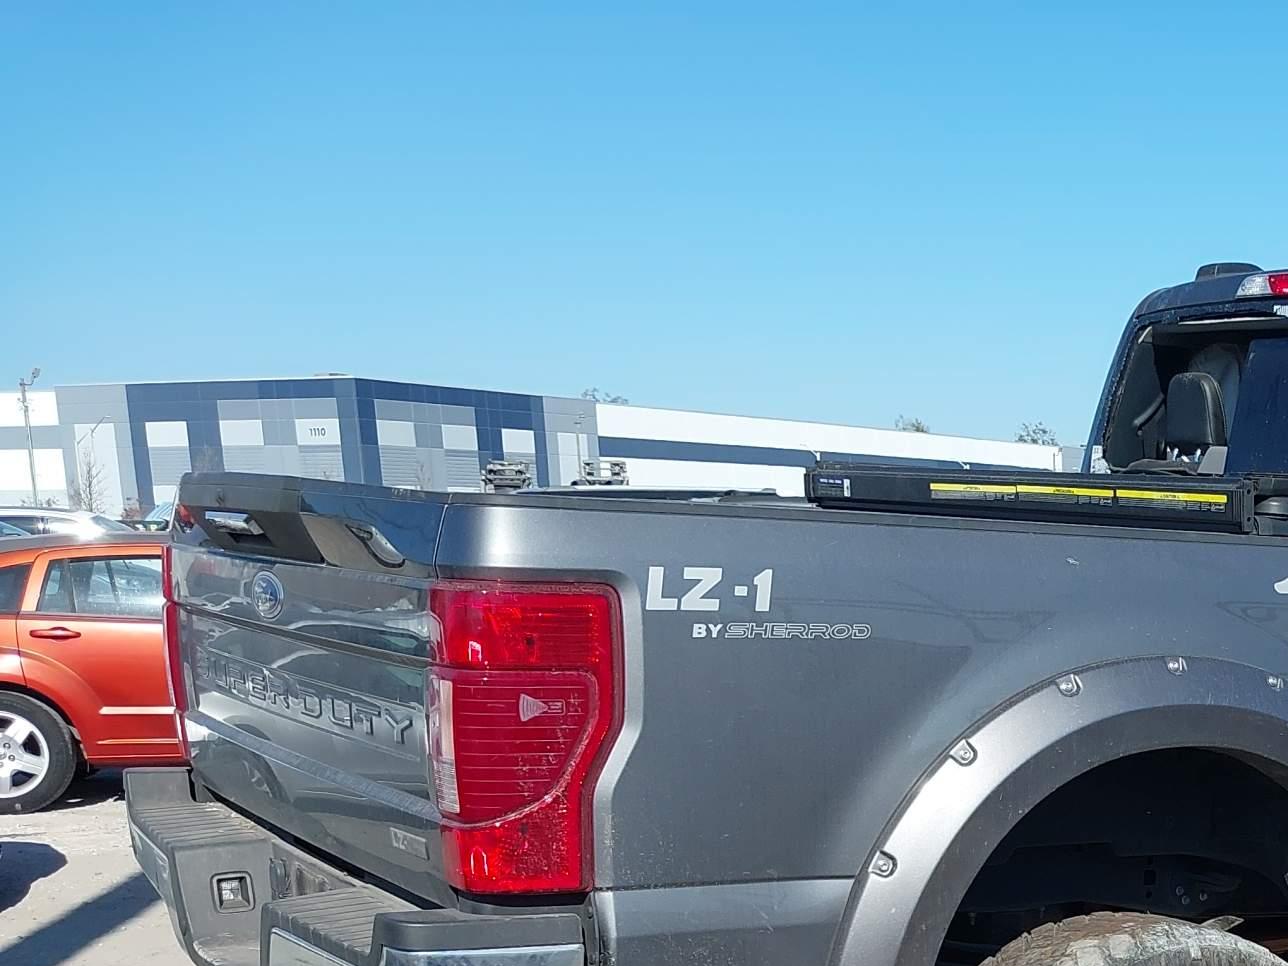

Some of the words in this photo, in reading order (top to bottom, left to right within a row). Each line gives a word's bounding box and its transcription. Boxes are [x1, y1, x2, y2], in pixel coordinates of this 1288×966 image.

[308, 427, 326, 437] 1110
[645, 566, 773, 612] LZ-1
[692, 623, 724, 639] BY
[724, 622, 872, 640] SHERROD
[299, 686, 414, 745] DUTY
